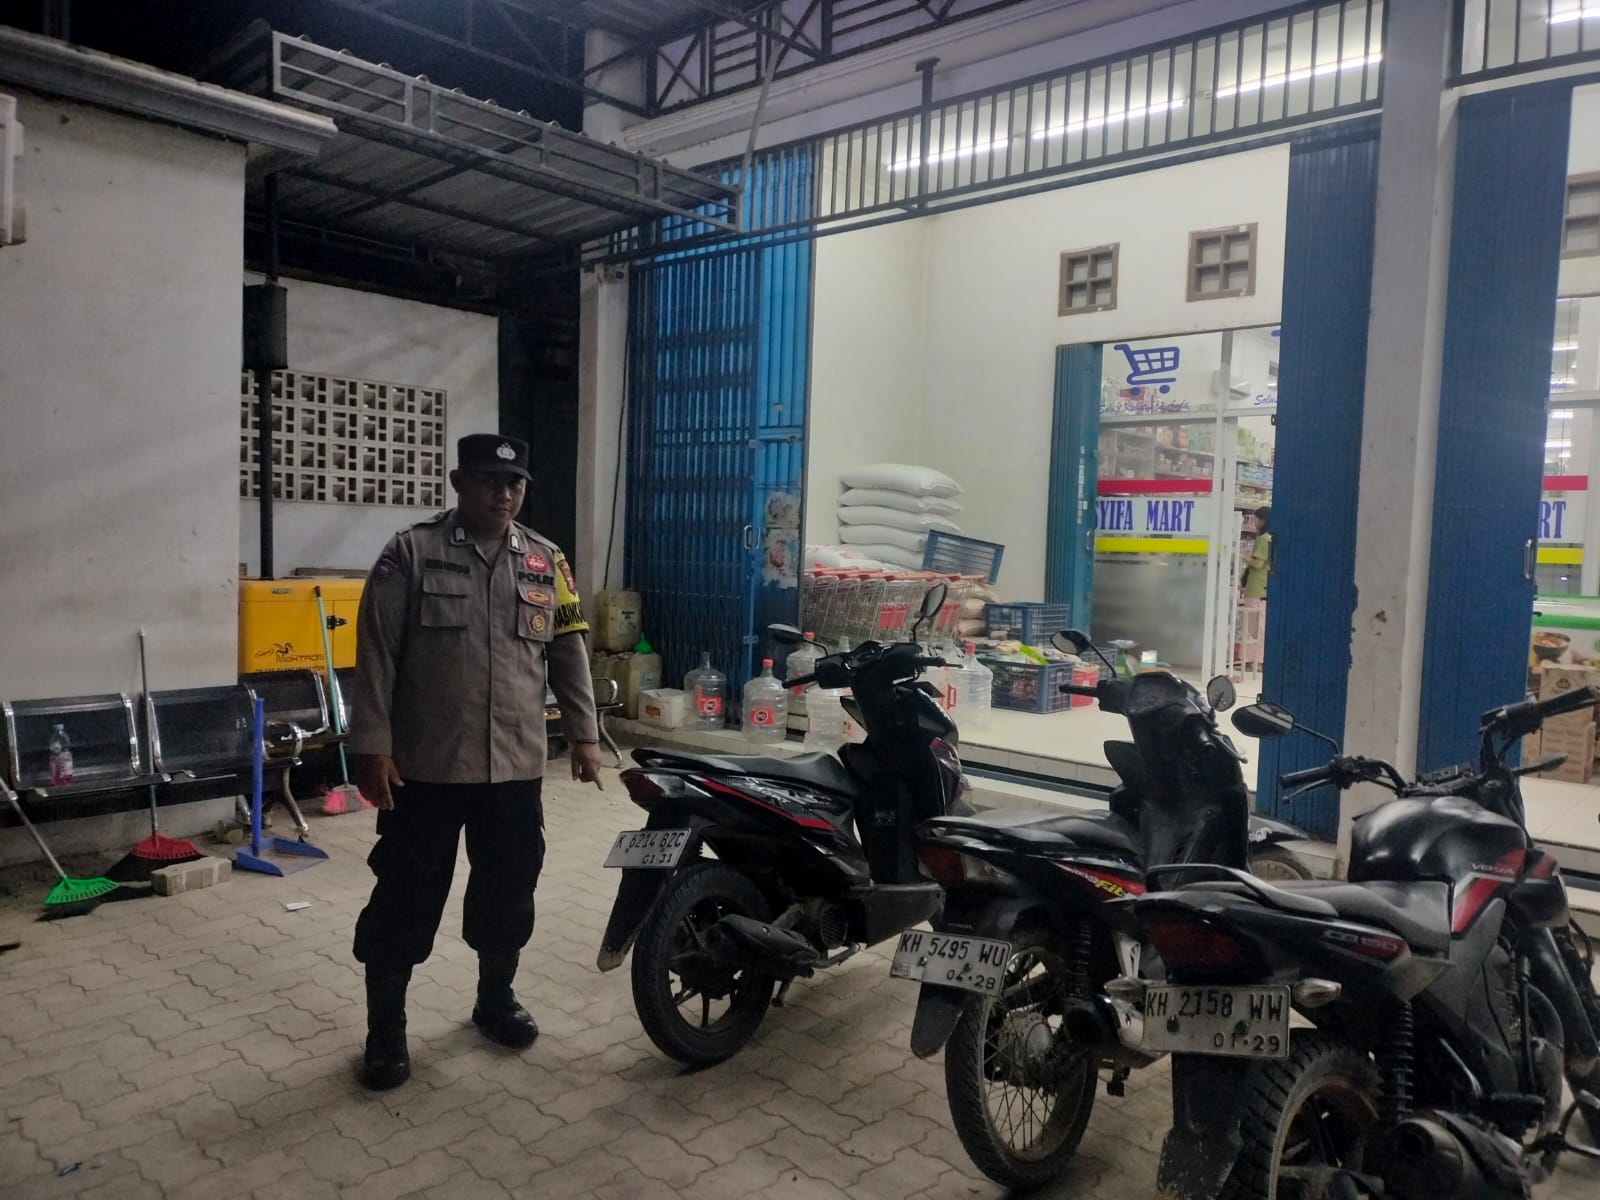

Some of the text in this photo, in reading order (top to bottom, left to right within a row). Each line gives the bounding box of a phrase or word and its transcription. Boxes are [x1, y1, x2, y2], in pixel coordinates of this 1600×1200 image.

[1146, 500, 1195, 532] MART
[615, 834, 627, 848] K
[899, 933, 1006, 967] KH 5495 WU
[1146, 989, 1283, 1021] KH 2158 WW
